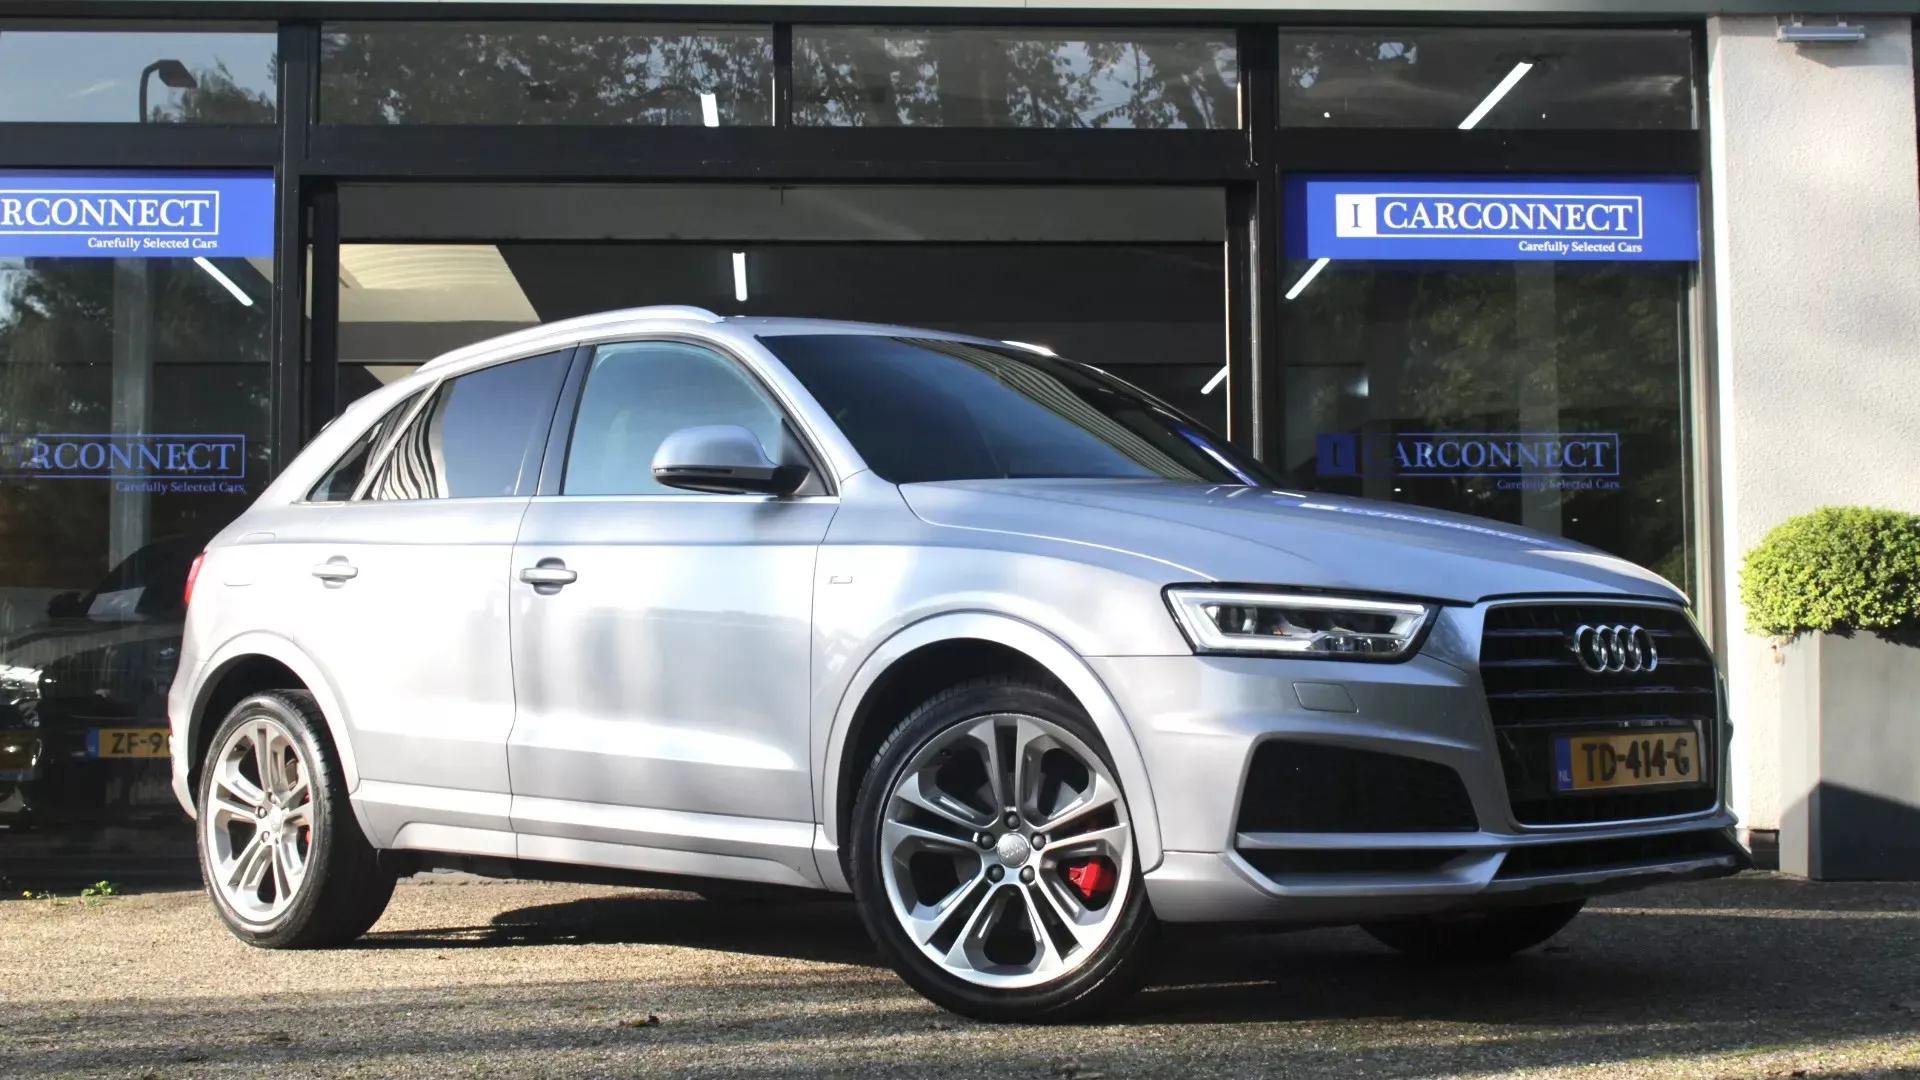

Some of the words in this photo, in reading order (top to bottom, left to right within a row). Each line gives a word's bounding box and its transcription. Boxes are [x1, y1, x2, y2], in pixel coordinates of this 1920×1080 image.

[0, 198, 210, 227] RCONNECT
[1383, 201, 1633, 231] CARCONNECT
[87, 237, 141, 251] Carefully
[143, 238, 189, 249] Selected
[192, 238, 218, 249] Cars
[1518, 241, 1570, 255] Carefully
[1571, 241, 1616, 253] Selected
[1618, 242, 1643, 253] Cars
[170, 481, 216, 492] Selected
[218, 481, 244, 493] Cars
[1549, 479, 1593, 490] Selected
[1596, 478, 1620, 490] Cars
[111, 731, 170, 754] ZF-9
[1581, 738, 1690, 782] TD-414-G
[1558, 769, 1570, 782] NL
